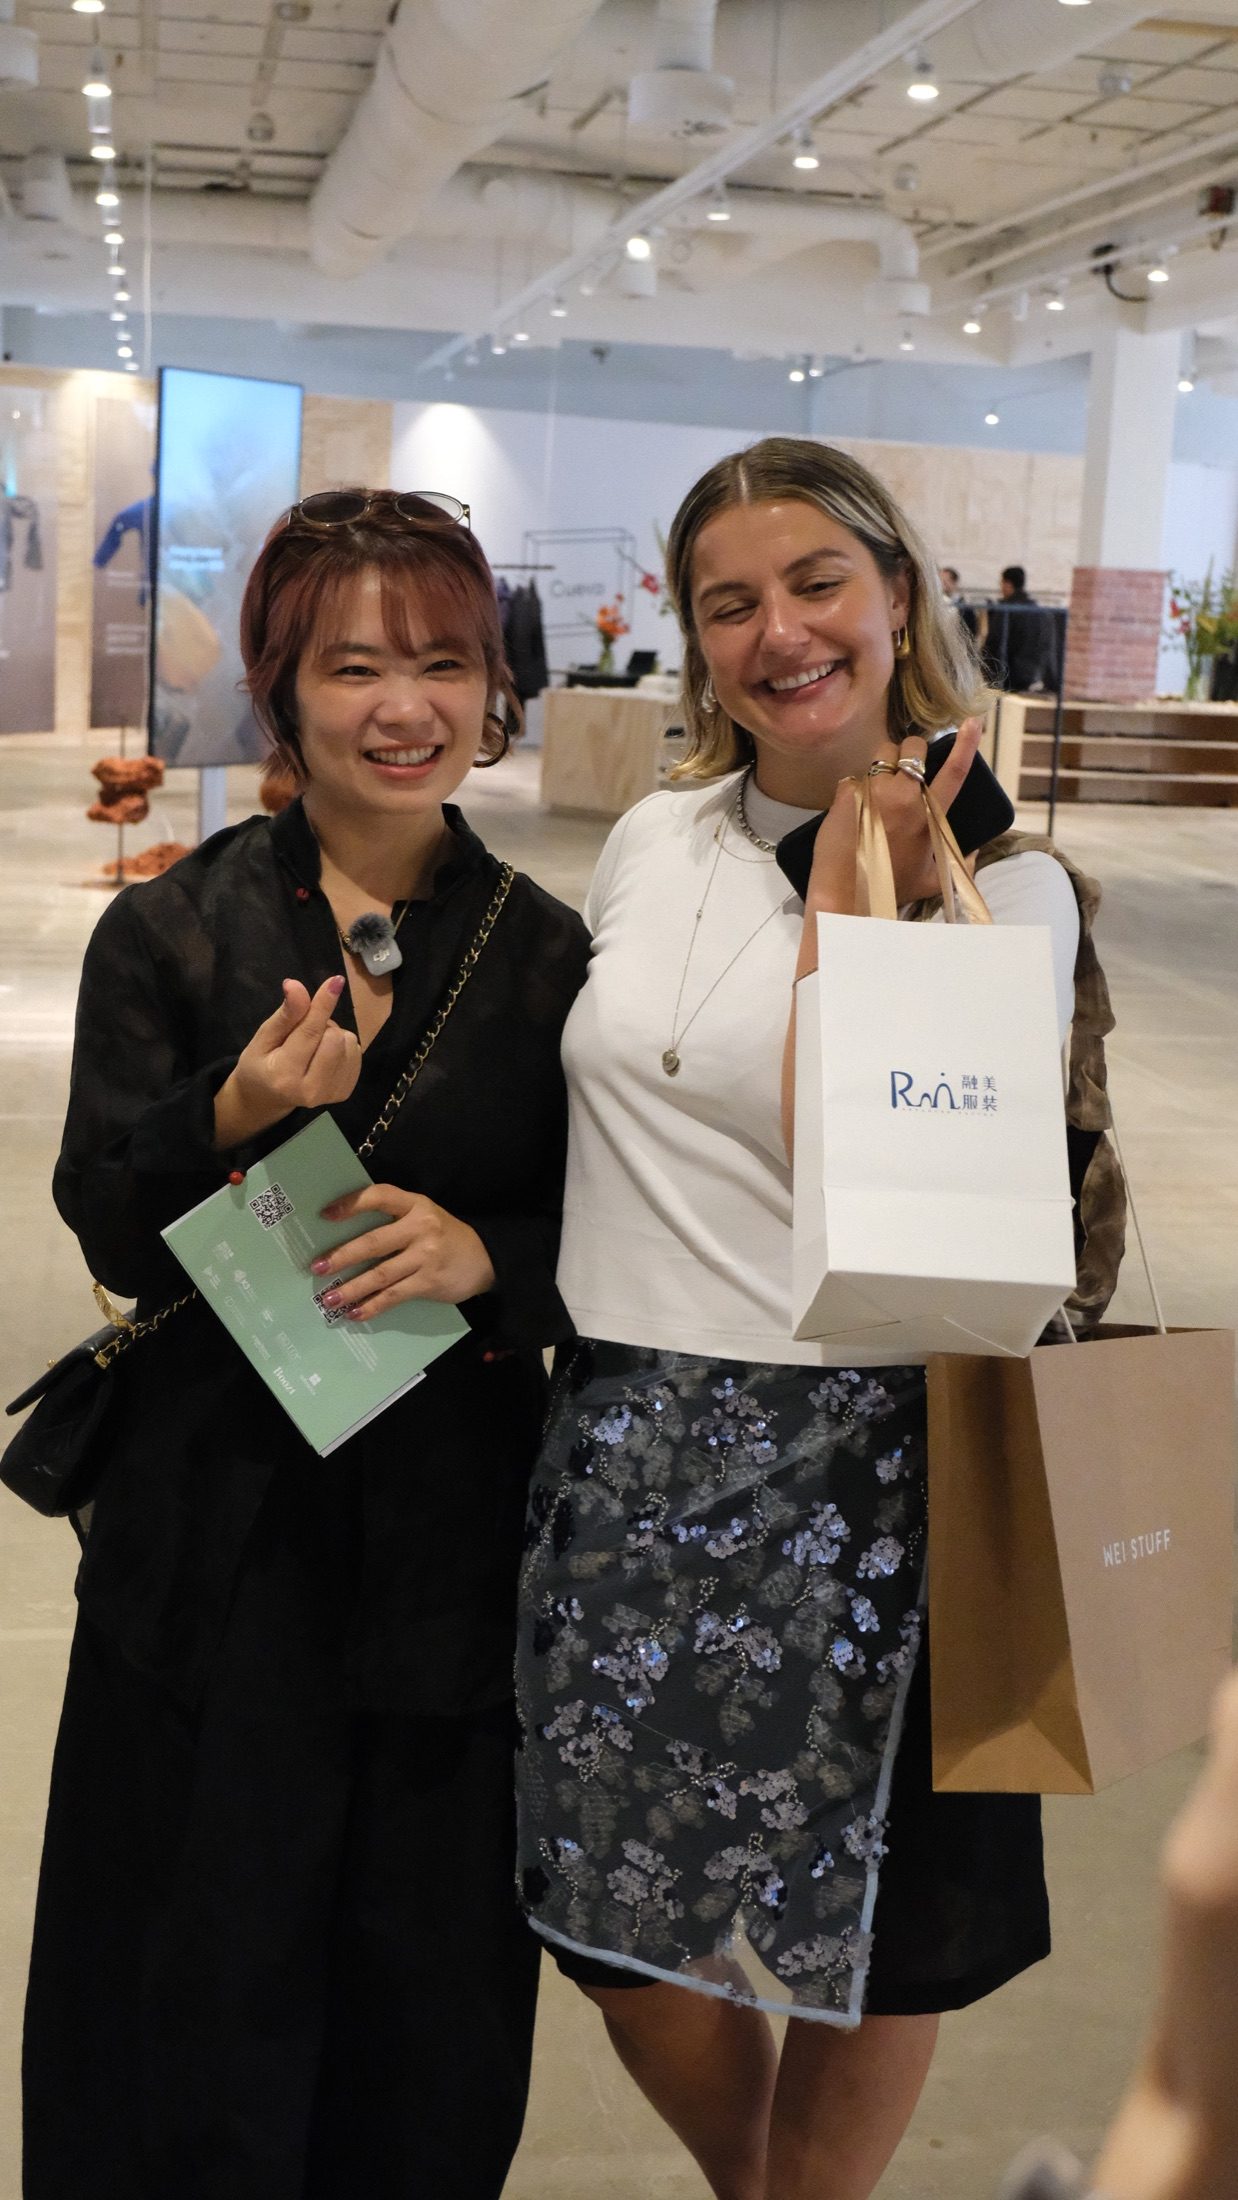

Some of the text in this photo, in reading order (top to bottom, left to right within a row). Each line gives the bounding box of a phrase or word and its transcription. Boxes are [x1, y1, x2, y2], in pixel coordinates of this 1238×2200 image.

[961, 1074, 998, 1092] 融美
[1103, 1529, 1172, 1568] WEI STUFF
